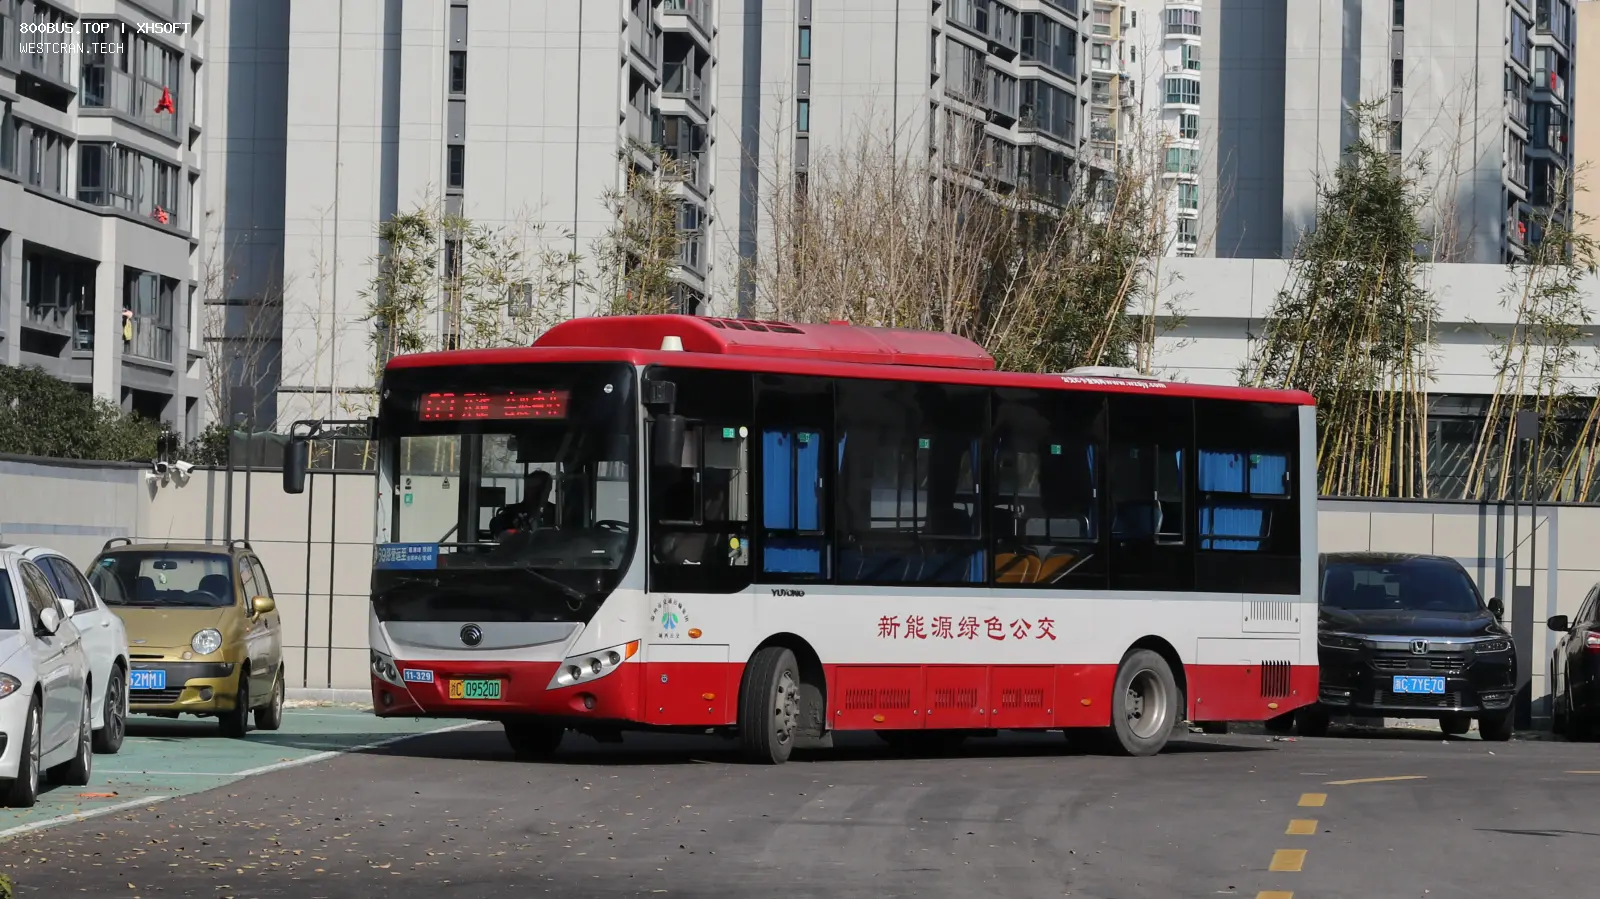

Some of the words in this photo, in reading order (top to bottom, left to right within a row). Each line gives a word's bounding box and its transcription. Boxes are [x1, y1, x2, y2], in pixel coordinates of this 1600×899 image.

[771, 588, 805, 597] YUTONG
[877, 614, 1057, 641] 新能源绿色公交
[405, 671, 431, 681] 11-329
